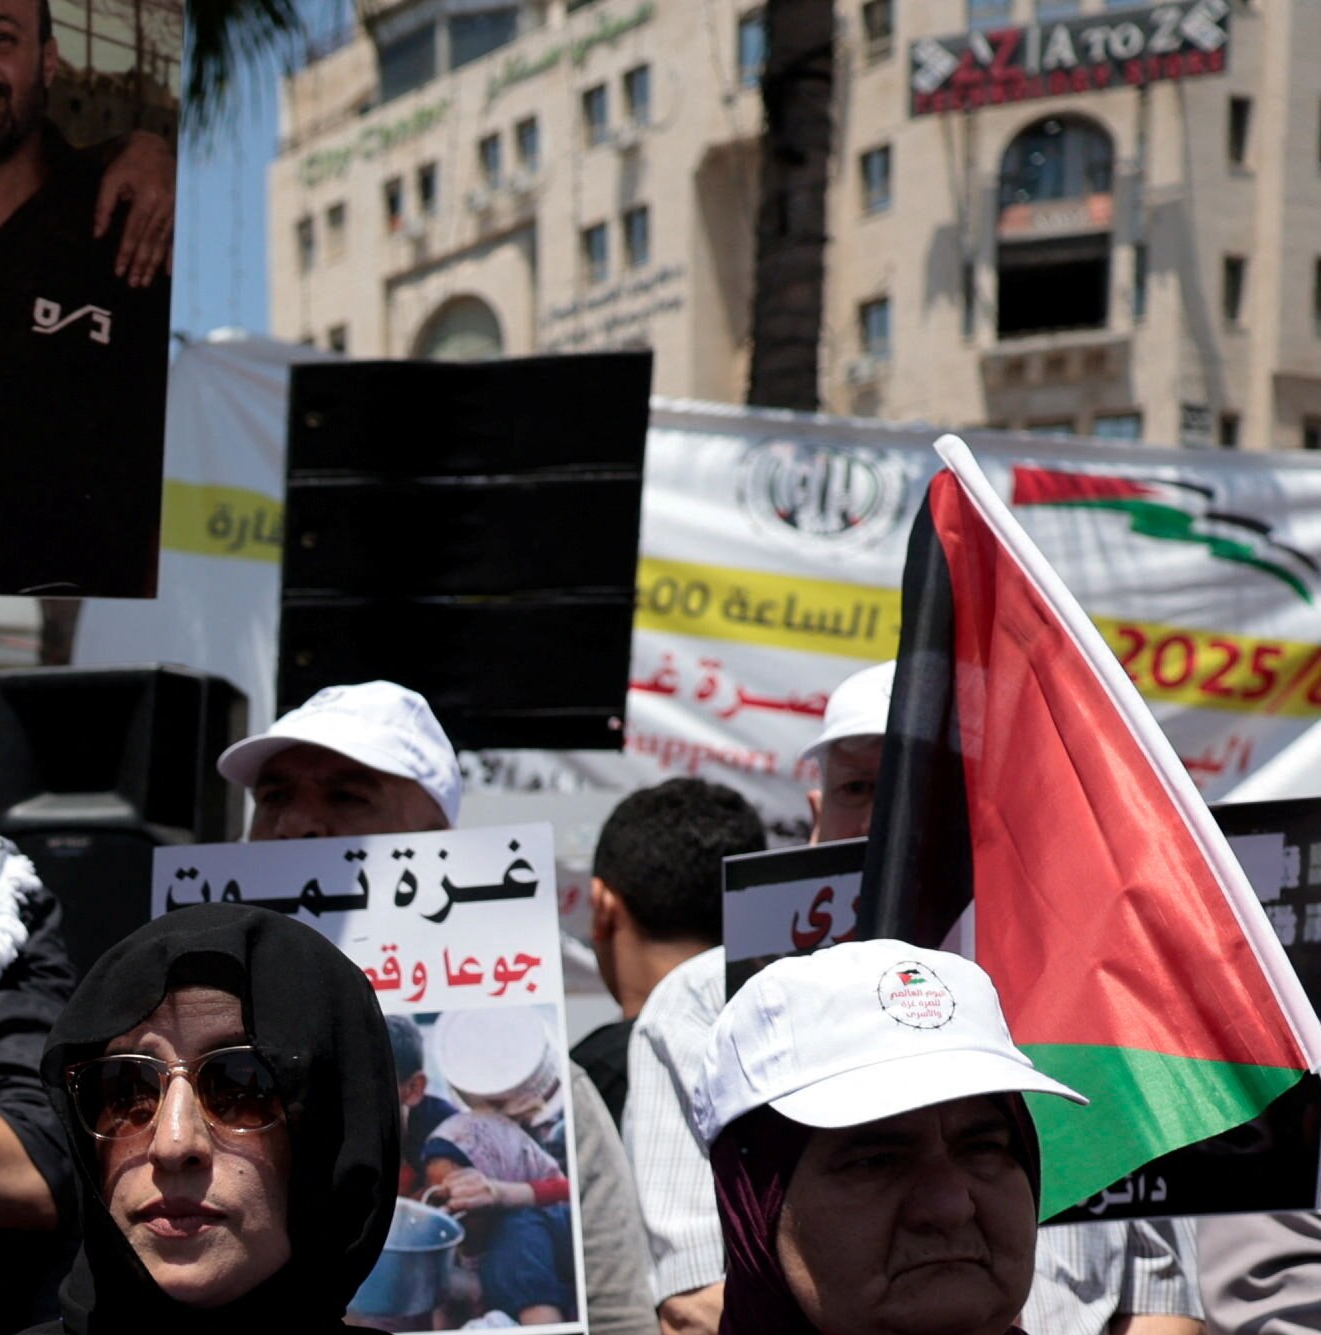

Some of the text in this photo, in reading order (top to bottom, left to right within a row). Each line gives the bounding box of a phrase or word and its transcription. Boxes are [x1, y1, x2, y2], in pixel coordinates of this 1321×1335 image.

[1124, 50, 1226, 86] STORE
[723, 592, 880, 640] الساعة
[694, 656, 830, 720] صرة
[166, 849, 370, 918] تموت
[393, 841, 537, 922] غزة
[445, 953, 541, 996] جوعا
